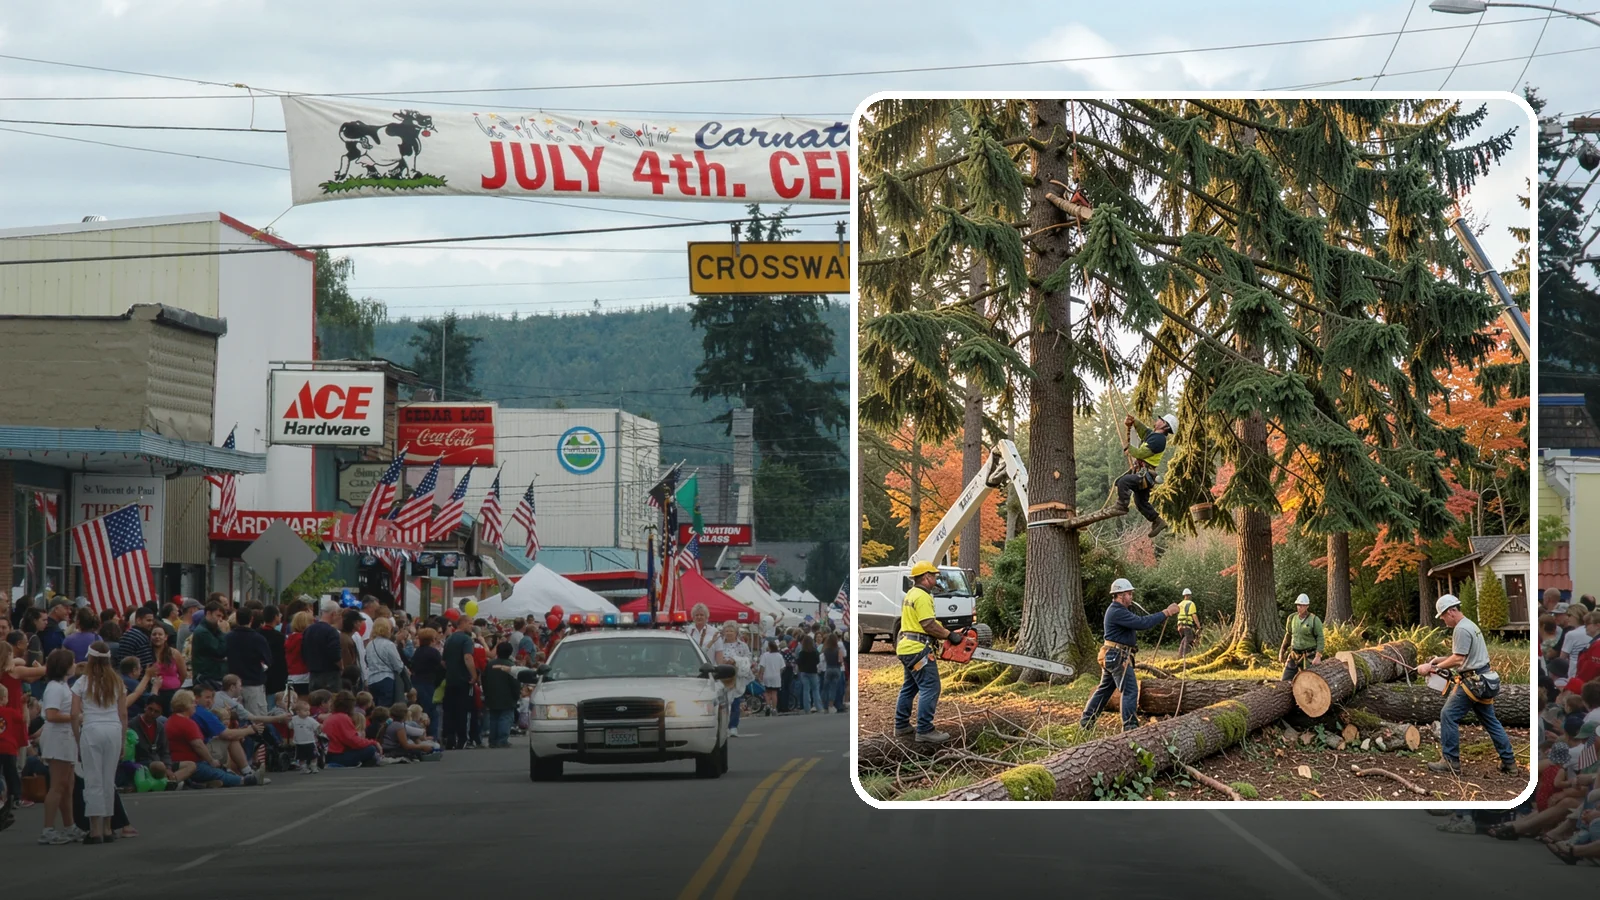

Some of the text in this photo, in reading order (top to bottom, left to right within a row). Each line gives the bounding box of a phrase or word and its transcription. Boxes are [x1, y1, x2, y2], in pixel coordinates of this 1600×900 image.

[695, 121, 850, 149] Carnat
[481, 141, 605, 192] JULY
[632, 149, 746, 198] 4th.
[697, 254, 850, 280] CROSSWA
[283, 380, 373, 420] ACE
[405, 409, 485, 422] CEDAR LOG
[283, 421, 370, 436] Hardware
[83, 484, 155, 495] St. Vincent de Paul
[80, 503, 154, 522] THT
[688, 526, 741, 535] CRNATION
[699, 535, 730, 543] GLASS
